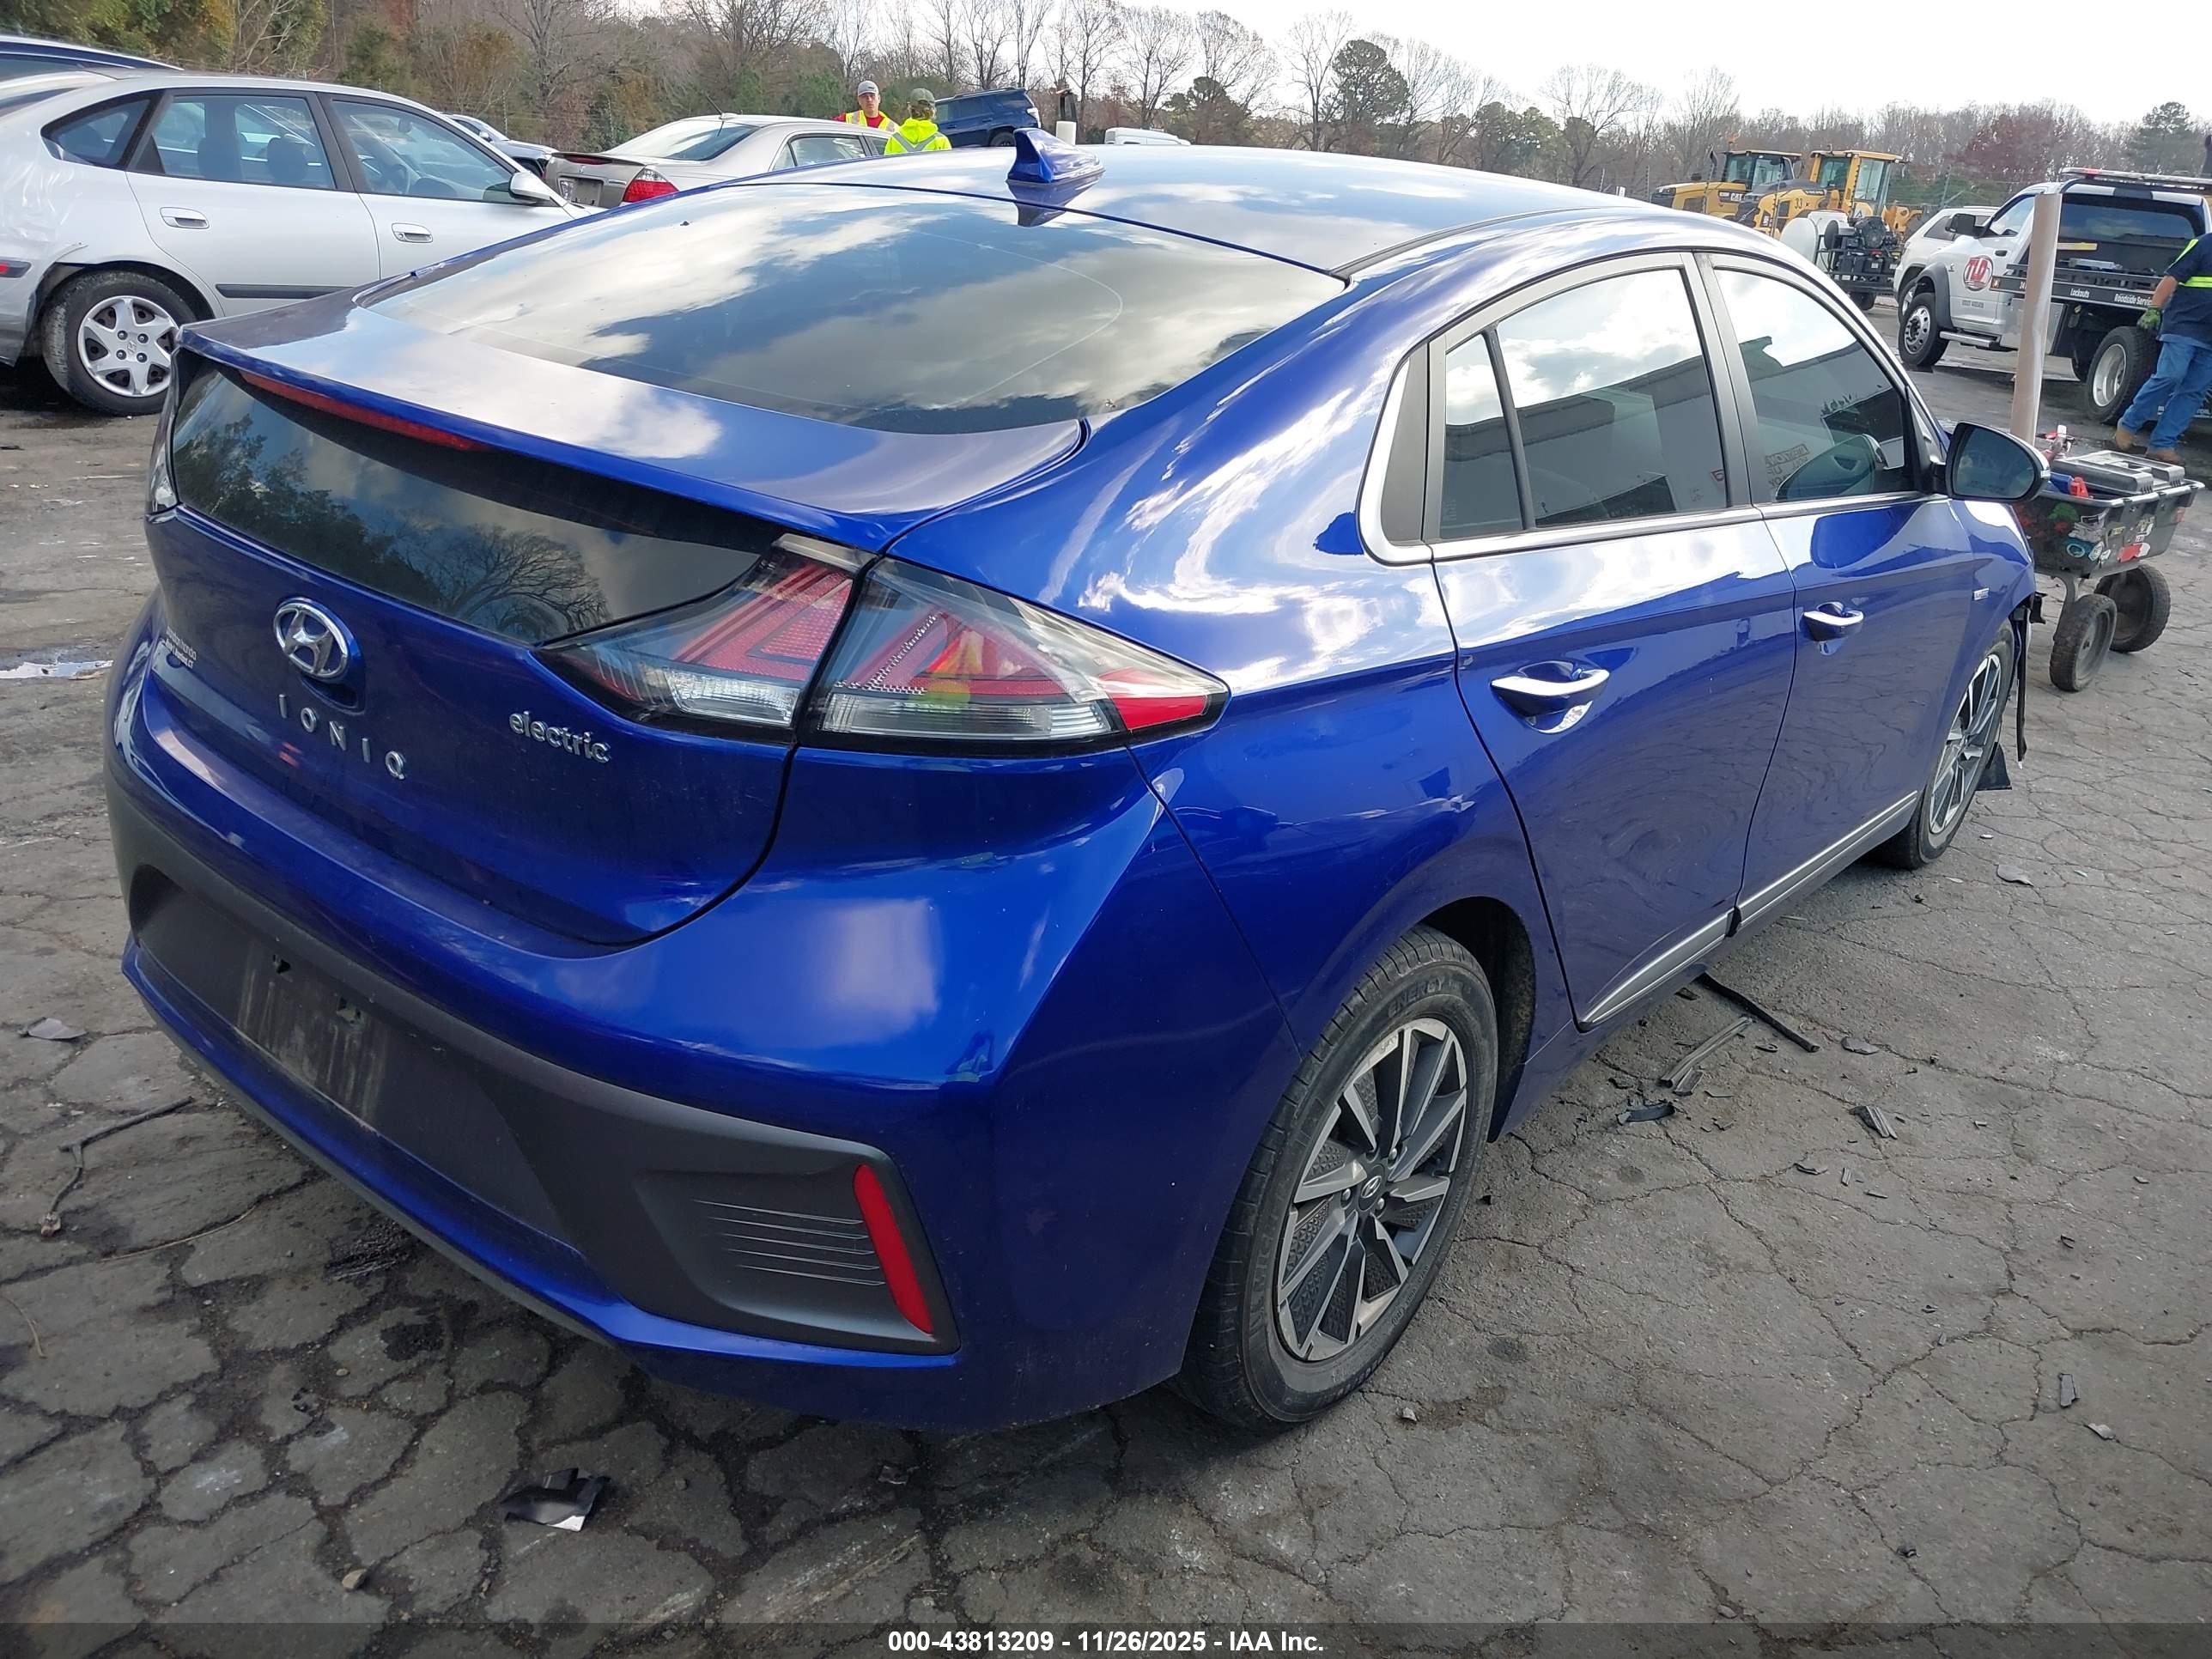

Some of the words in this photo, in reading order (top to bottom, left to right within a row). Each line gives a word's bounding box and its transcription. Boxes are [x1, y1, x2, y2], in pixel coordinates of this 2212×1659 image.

[1730, 192, 1742, 202] CAT
[2069, 288, 2090, 299] Lockouts
[2114, 294, 2136, 305] Roadside
[2136, 296, 2153, 307] Servic
[279, 694, 408, 780] IONIQ
[509, 710, 611, 763] electric
